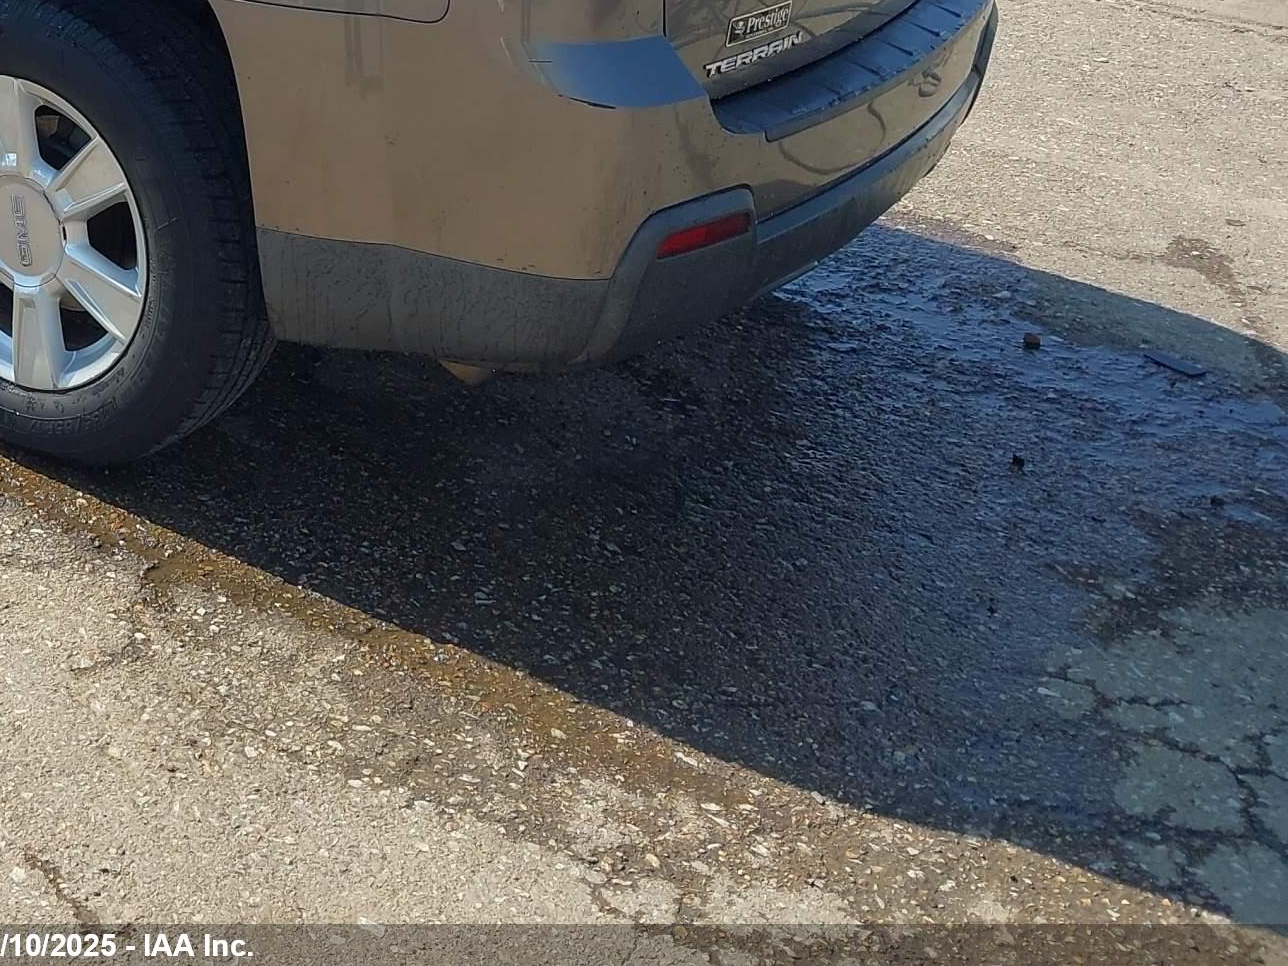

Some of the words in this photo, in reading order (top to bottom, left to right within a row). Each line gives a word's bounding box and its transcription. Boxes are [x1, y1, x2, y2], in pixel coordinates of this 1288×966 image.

[746, 7, 790, 34] Prestige
[704, 30, 804, 77] TERRAIN
[11, 194, 33, 268] GMC
